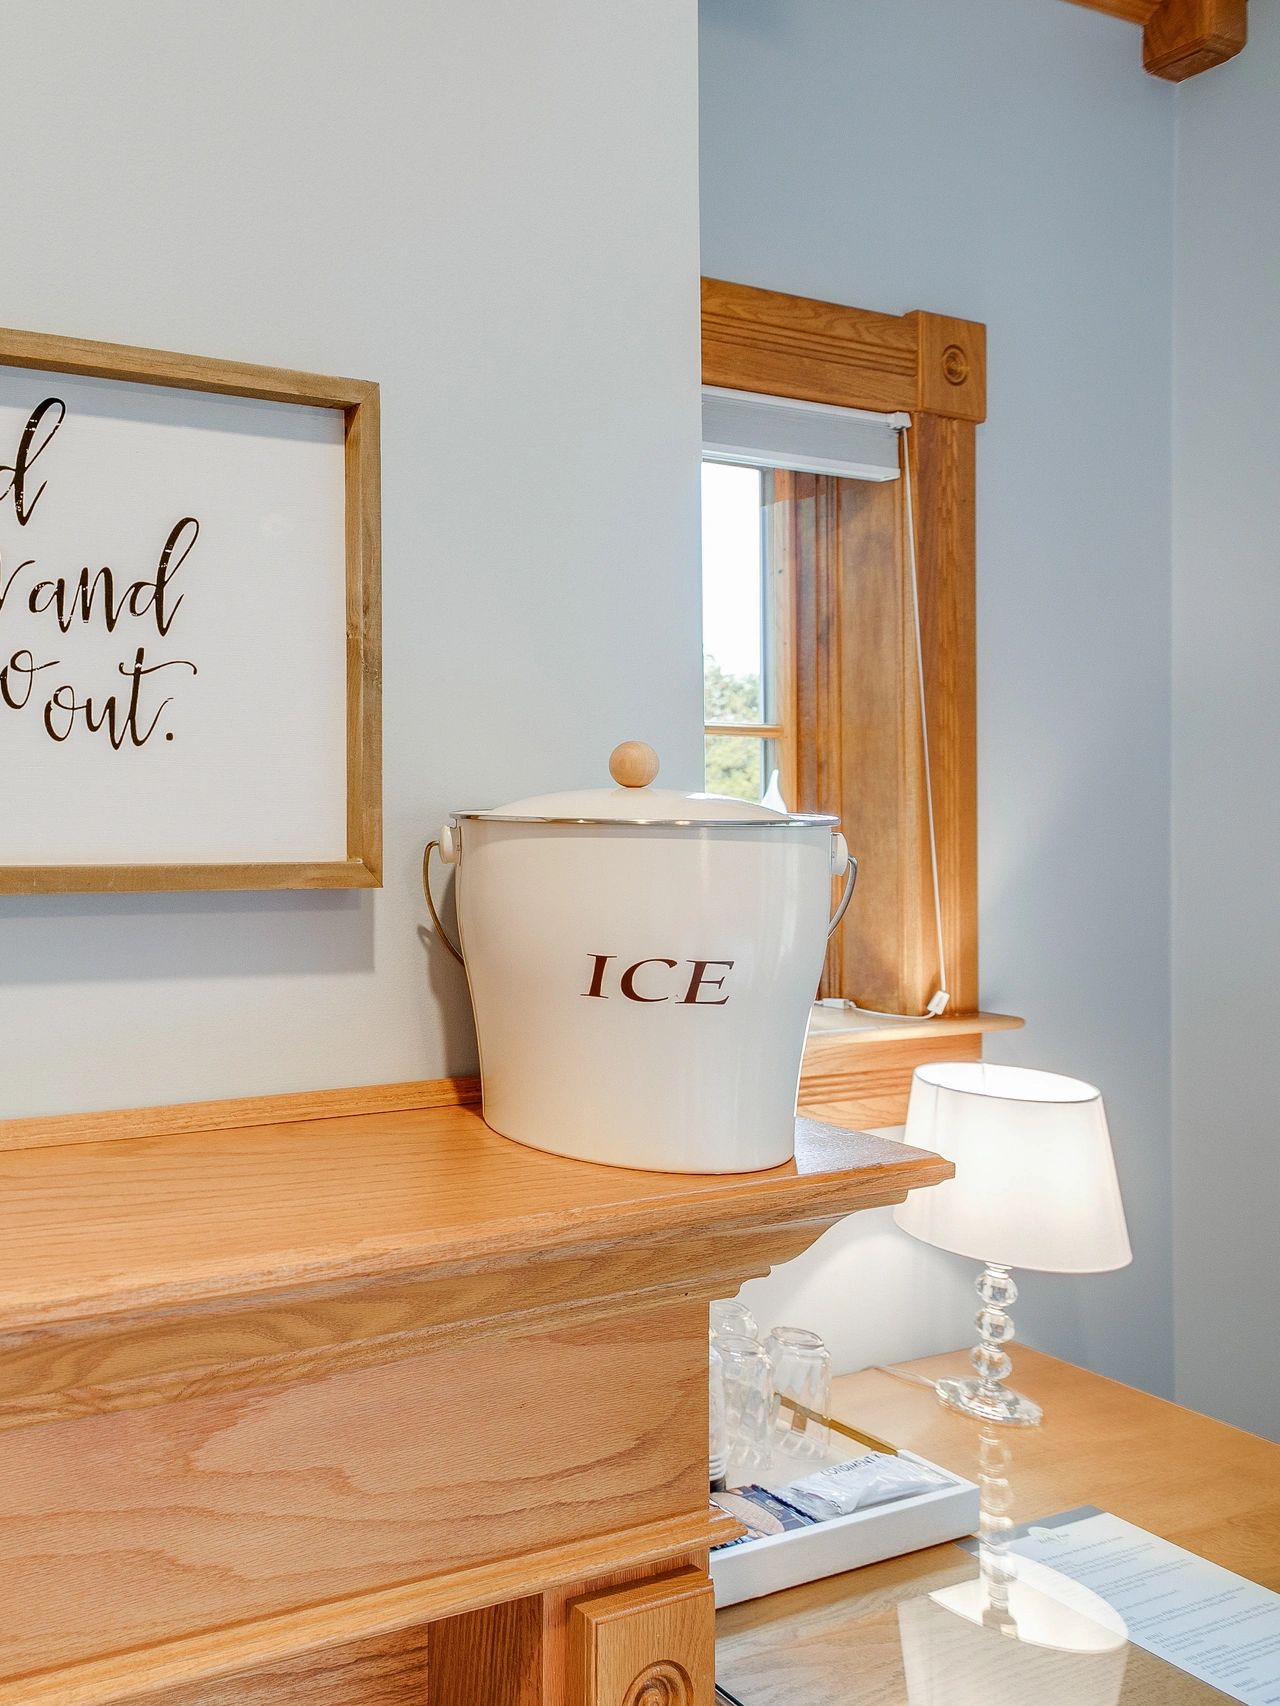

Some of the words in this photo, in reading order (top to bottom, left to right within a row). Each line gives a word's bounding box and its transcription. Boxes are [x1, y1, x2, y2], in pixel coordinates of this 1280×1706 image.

[29, 517, 199, 637] and
[44, 647, 197, 750] out.
[580, 953, 734, 1004] ICE
